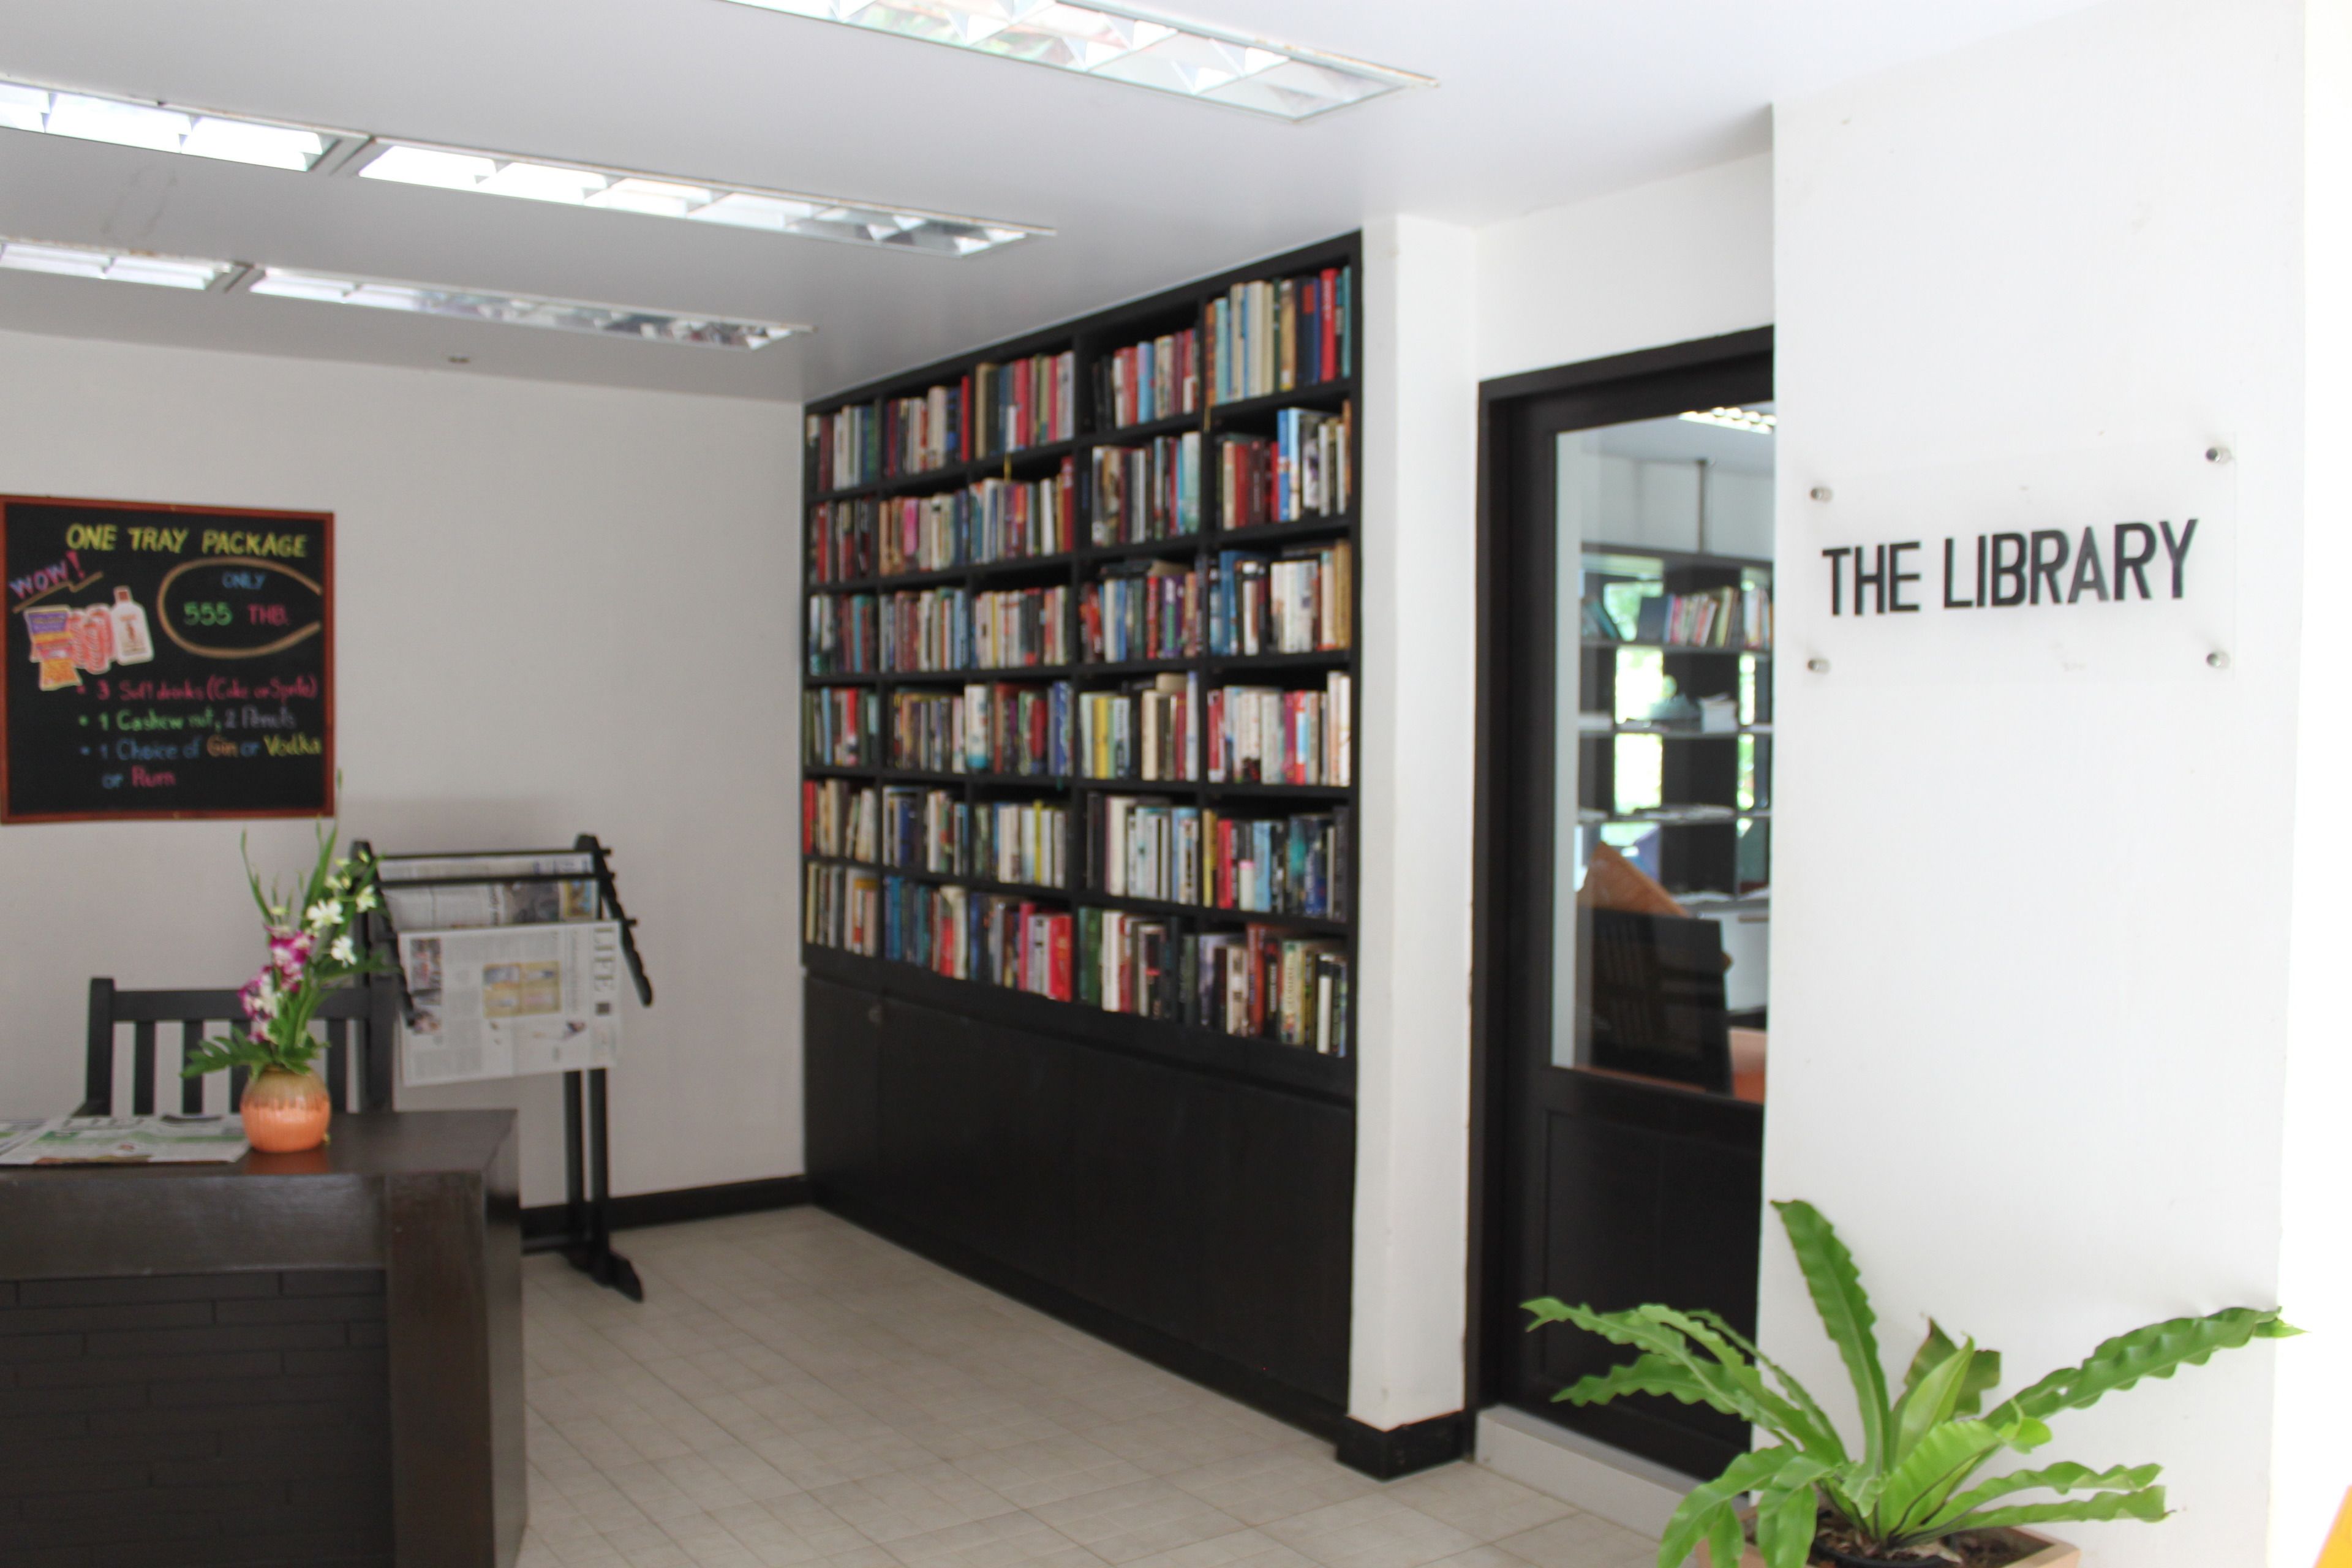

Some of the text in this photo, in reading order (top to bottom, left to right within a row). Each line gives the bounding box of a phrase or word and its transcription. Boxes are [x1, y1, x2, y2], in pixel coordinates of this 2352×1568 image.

[66, 524, 307, 557] ONE TRAY PACKAGE
[222, 571, 266, 589] ONLY
[1822, 518, 2199, 617] THE LIBRARY
[184, 601, 233, 626] 555
[97, 679, 110, 701] 3
[119, 679, 153, 701] Soft
[157, 679, 205, 701] drinks
[99, 711, 110, 731] 1
[116, 708, 184, 731] Cashew
[224, 708, 236, 729] 2
[100, 733, 323, 760] 1 Choice of Gin or Vodka
[102, 764, 176, 790] or Rum
